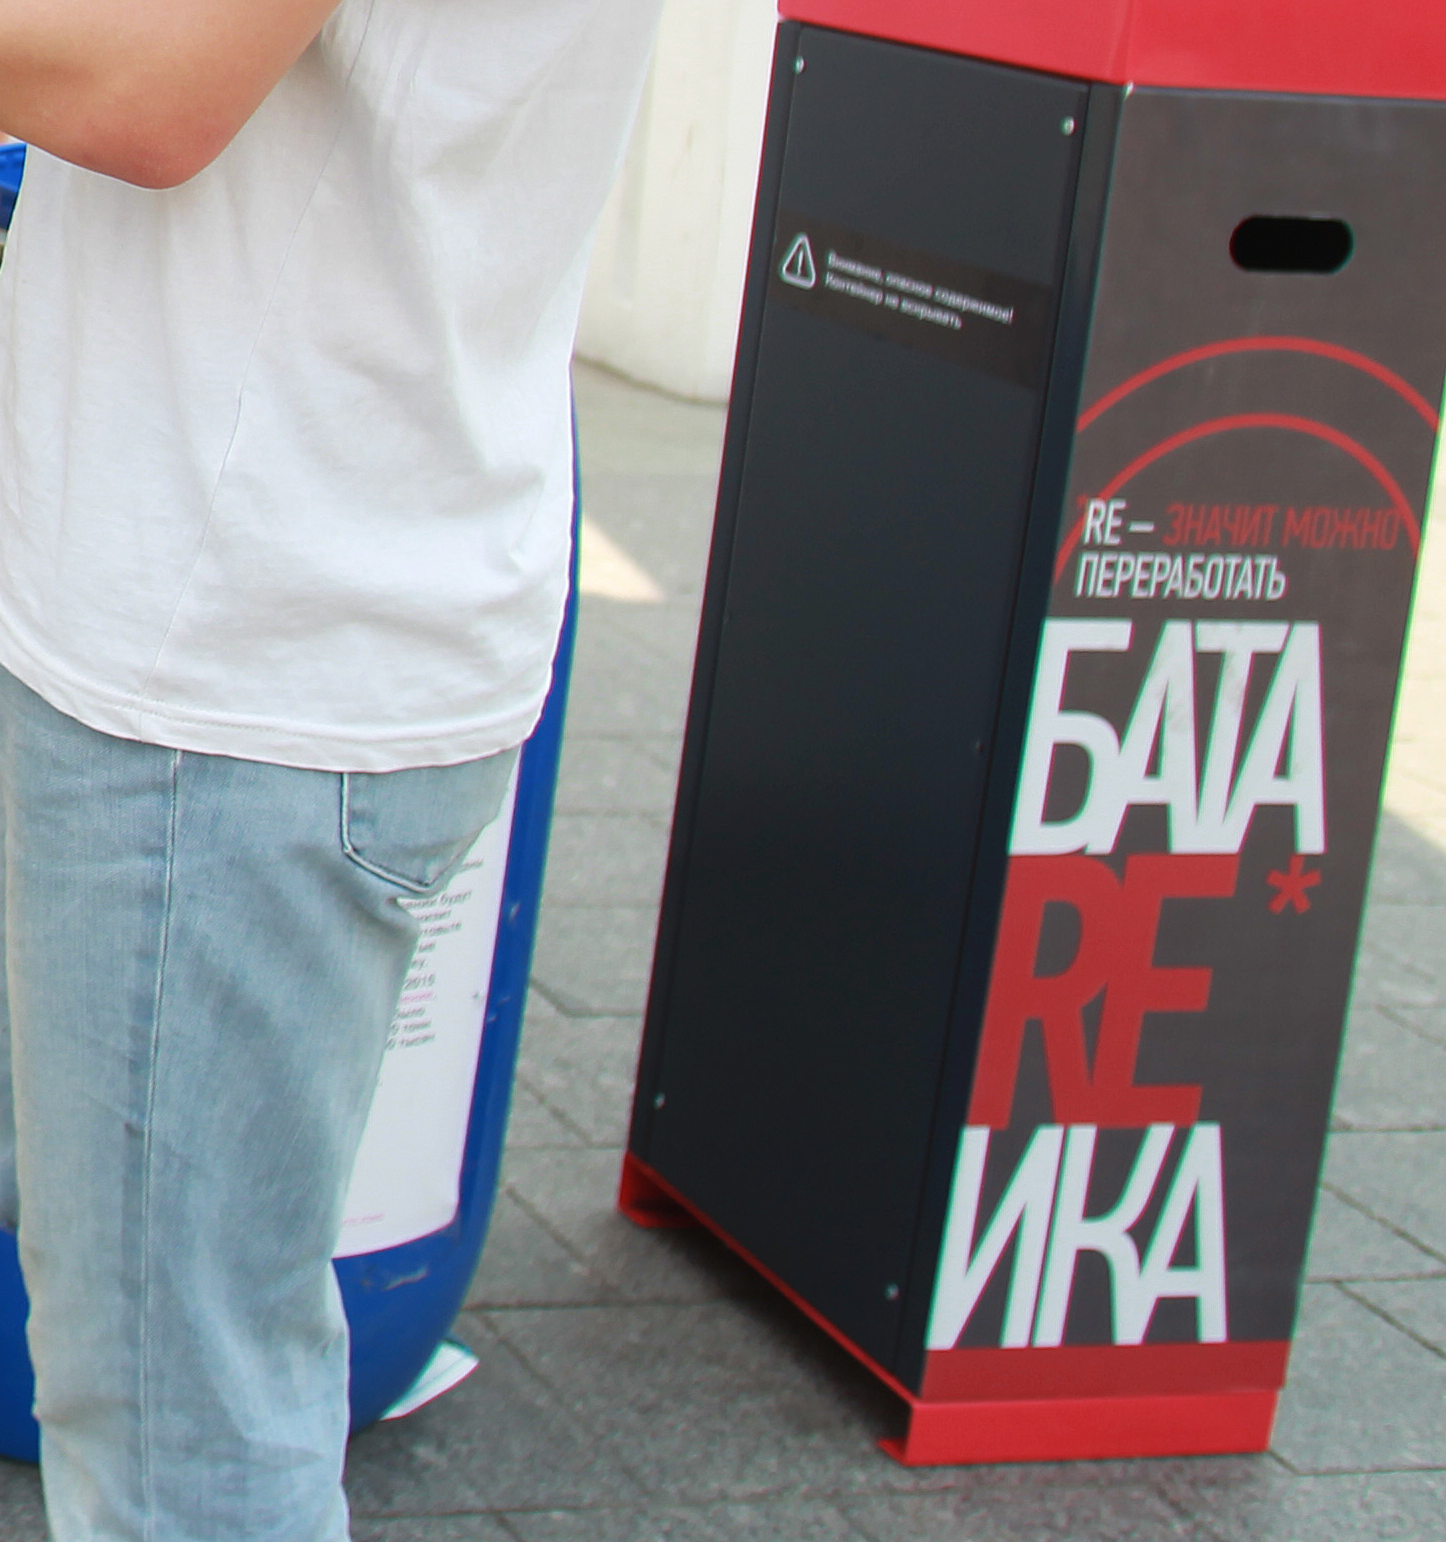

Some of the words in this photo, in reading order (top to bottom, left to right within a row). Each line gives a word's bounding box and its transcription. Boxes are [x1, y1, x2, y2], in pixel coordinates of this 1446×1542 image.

[1075, 551, 1290, 601] ПЕРЕРАБОТАТЬ
[1162, 503, 1280, 548] ЗНАЧИТ
[1281, 504, 1402, 551] МОЖНО
[1007, 619, 1328, 856] БАТА
[923, 1123, 1229, 1349] ИКА
